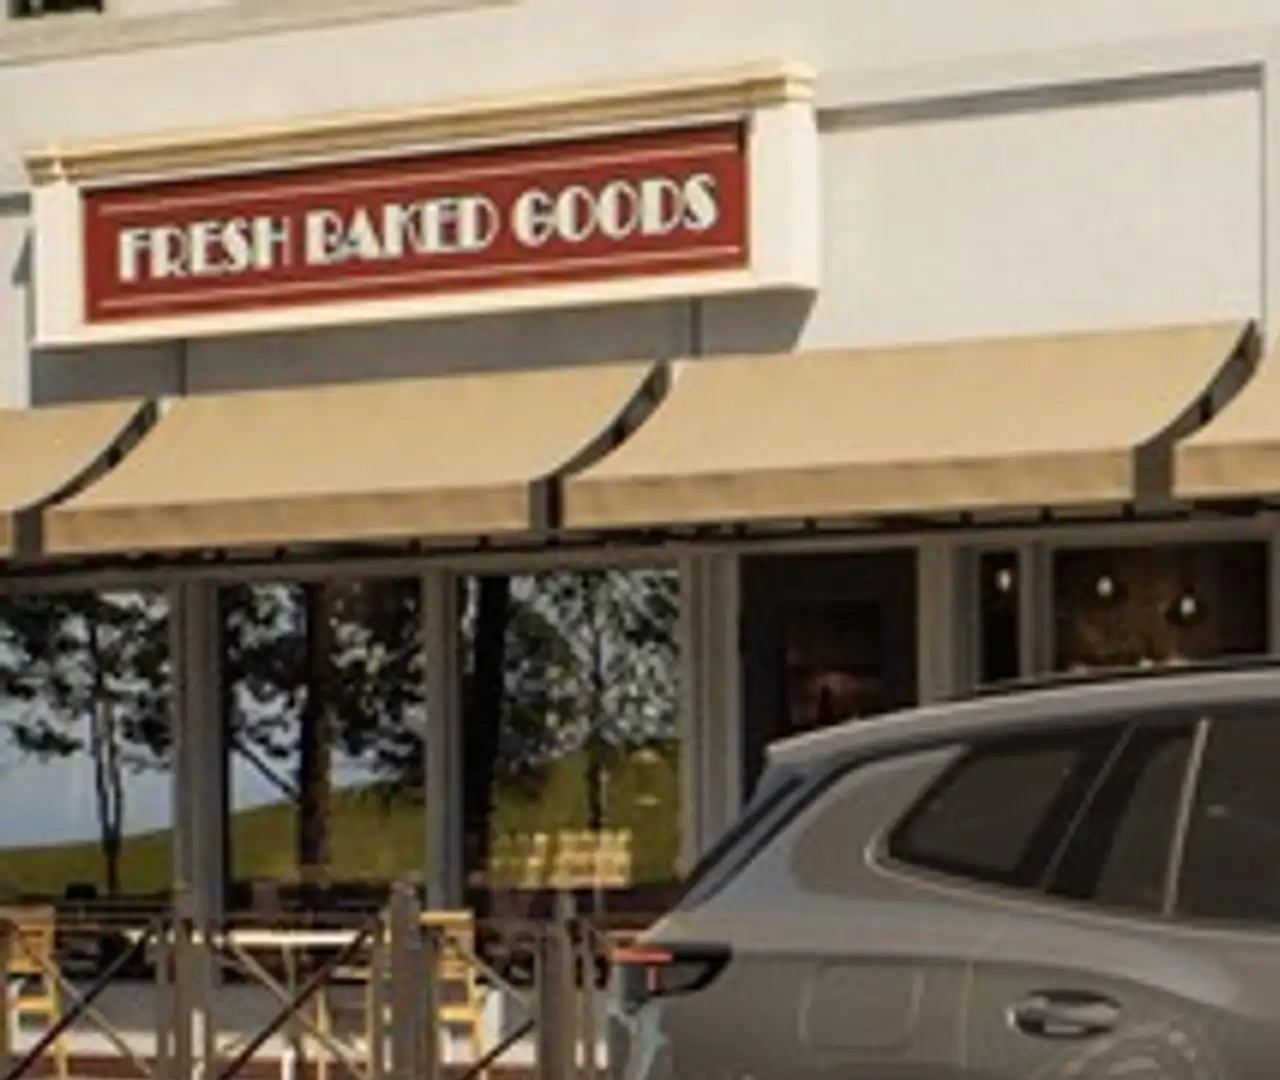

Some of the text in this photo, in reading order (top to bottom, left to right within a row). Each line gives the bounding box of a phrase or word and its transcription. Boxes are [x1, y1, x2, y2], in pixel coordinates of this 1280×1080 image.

[118, 173, 718, 284] FRESH BAKED GOODS
